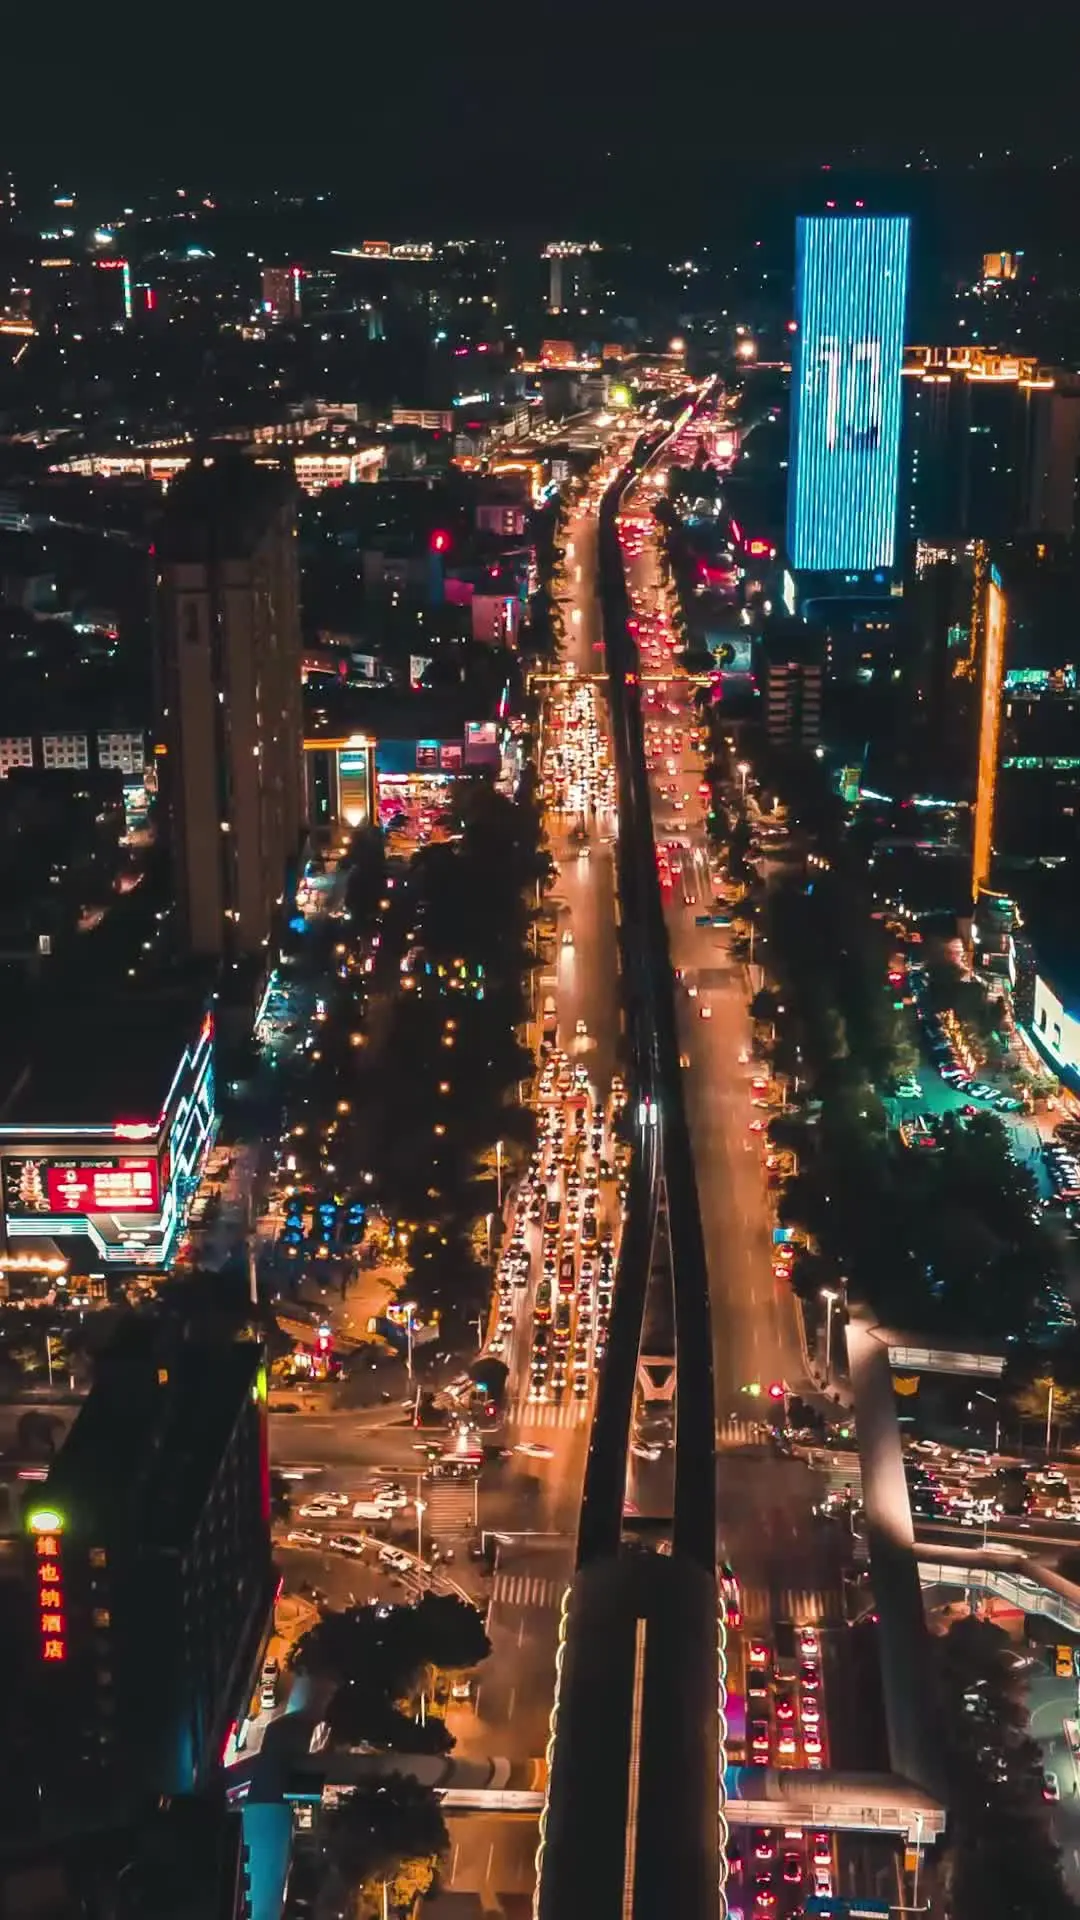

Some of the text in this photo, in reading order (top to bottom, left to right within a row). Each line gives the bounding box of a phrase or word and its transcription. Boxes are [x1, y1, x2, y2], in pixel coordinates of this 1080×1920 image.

[37, 1536, 63, 1658] 维也纳酒店
